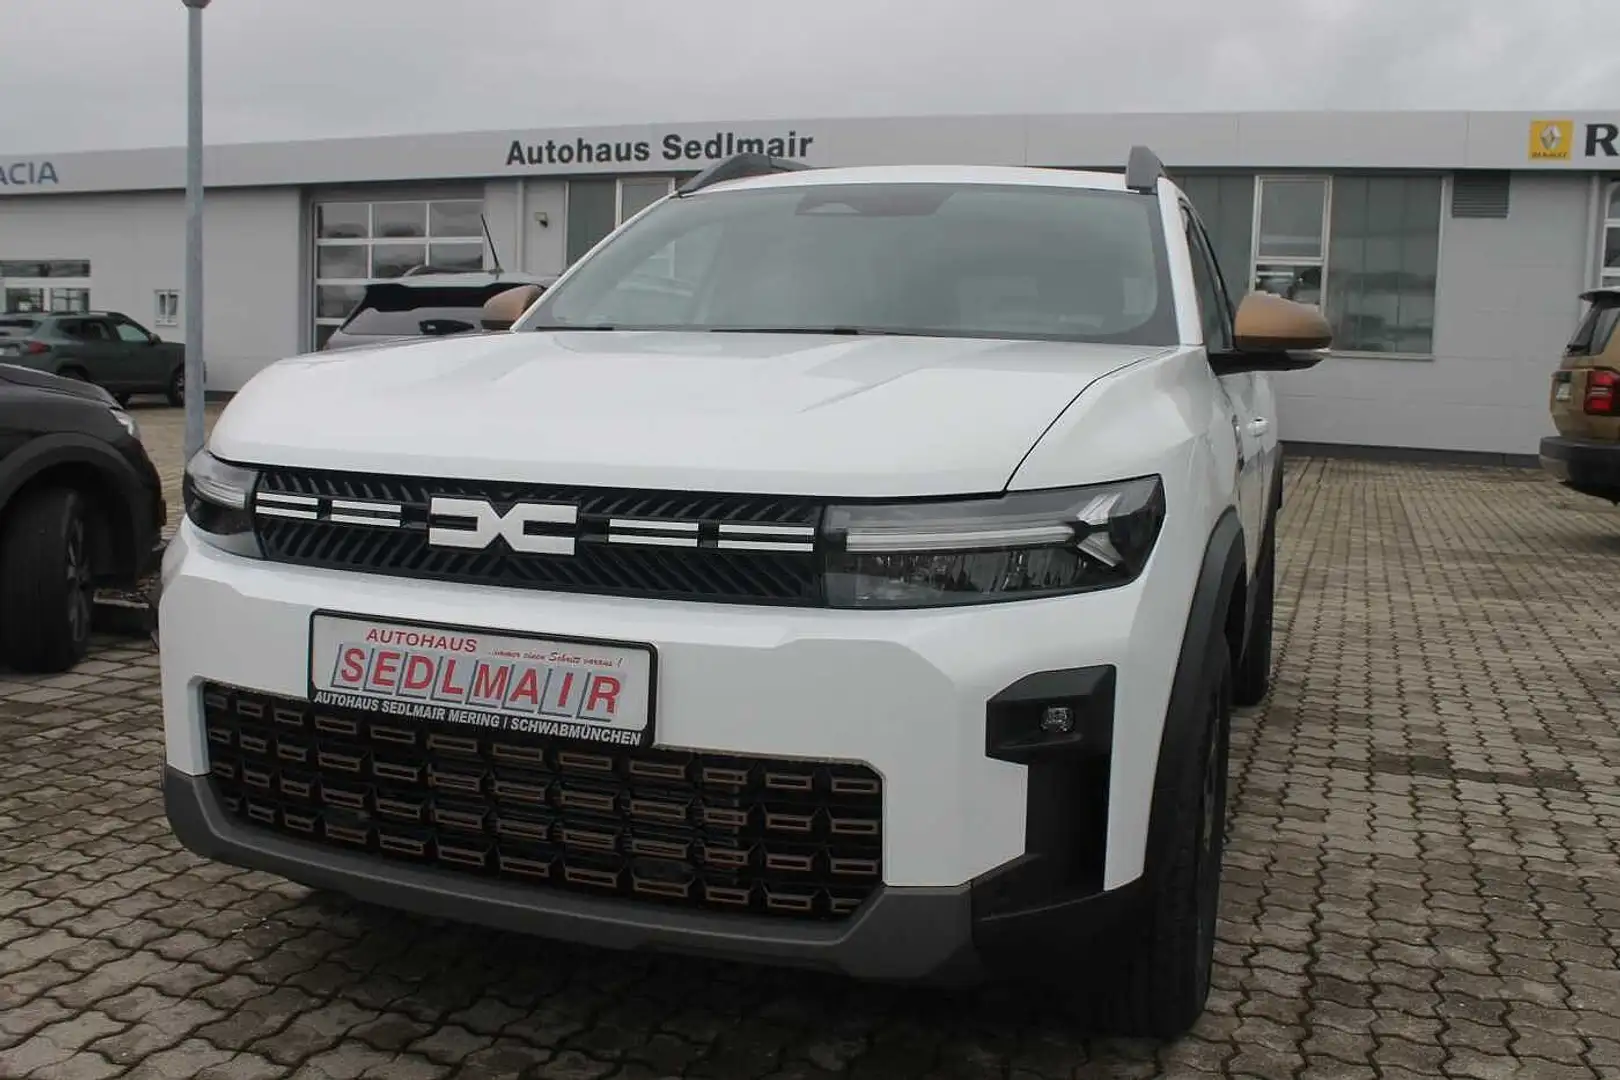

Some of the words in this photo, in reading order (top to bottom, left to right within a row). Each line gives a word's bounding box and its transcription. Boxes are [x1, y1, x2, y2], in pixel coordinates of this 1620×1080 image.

[506, 138, 650, 165] Autohaus
[662, 130, 814, 160] Sedlmair
[1585, 123, 1619, 157] R
[366, 628, 477, 653] AUTOHAUS
[341, 648, 621, 713] SEDLMAIR
[314, 691, 379, 711] AUTOHAUS
[381, 700, 446, 722] SEDLMAIR
[447, 709, 500, 727] MERING
[510, 717, 642, 746] SCHWABMÜNCHEN
